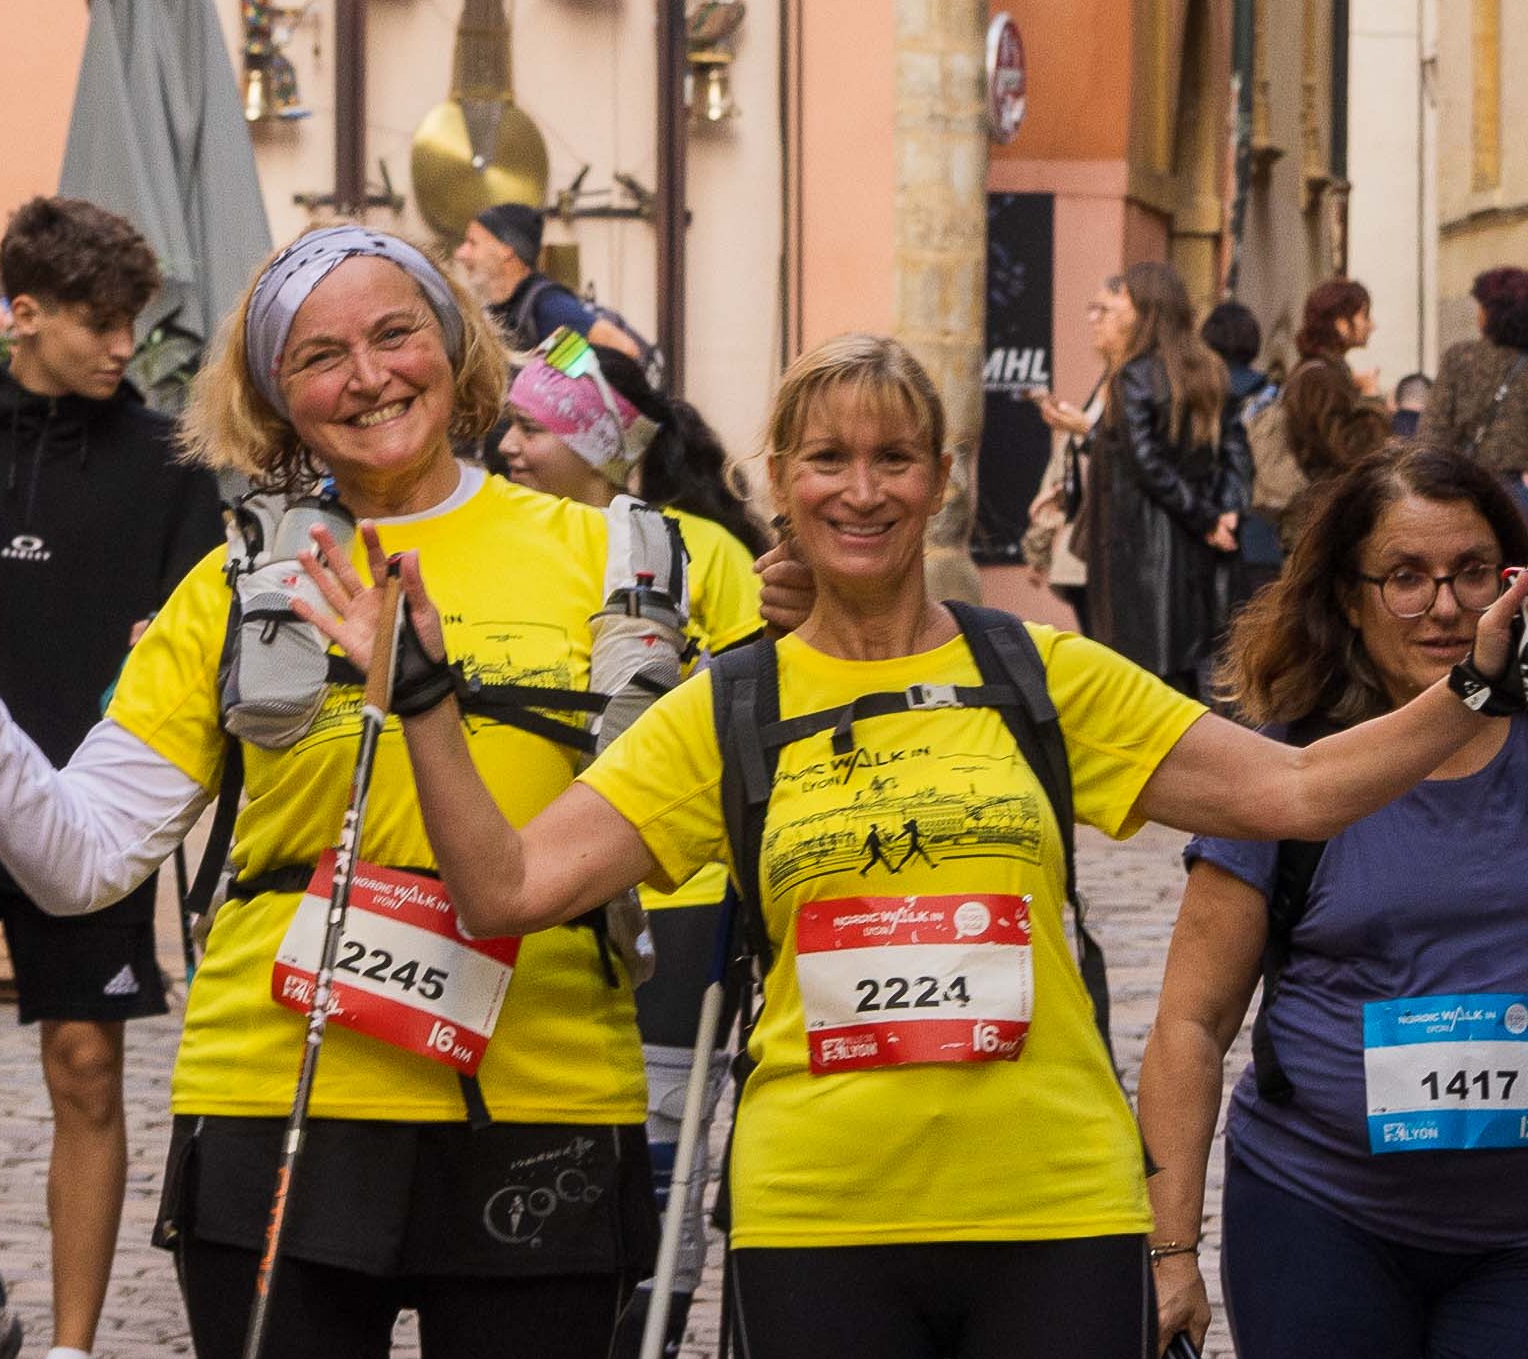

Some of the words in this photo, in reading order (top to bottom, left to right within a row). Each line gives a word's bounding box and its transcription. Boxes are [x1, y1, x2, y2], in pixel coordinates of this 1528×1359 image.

[350, 875, 393, 895] NORDIC
[394, 882, 435, 910] WALK
[335, 940, 449, 1001] 2245
[856, 976, 970, 1012] 2224
[427, 1021, 457, 1052] 16
[453, 1044, 472, 1063] KM
[973, 1021, 999, 1052] 16
[1422, 1070, 1518, 1101] 1417
